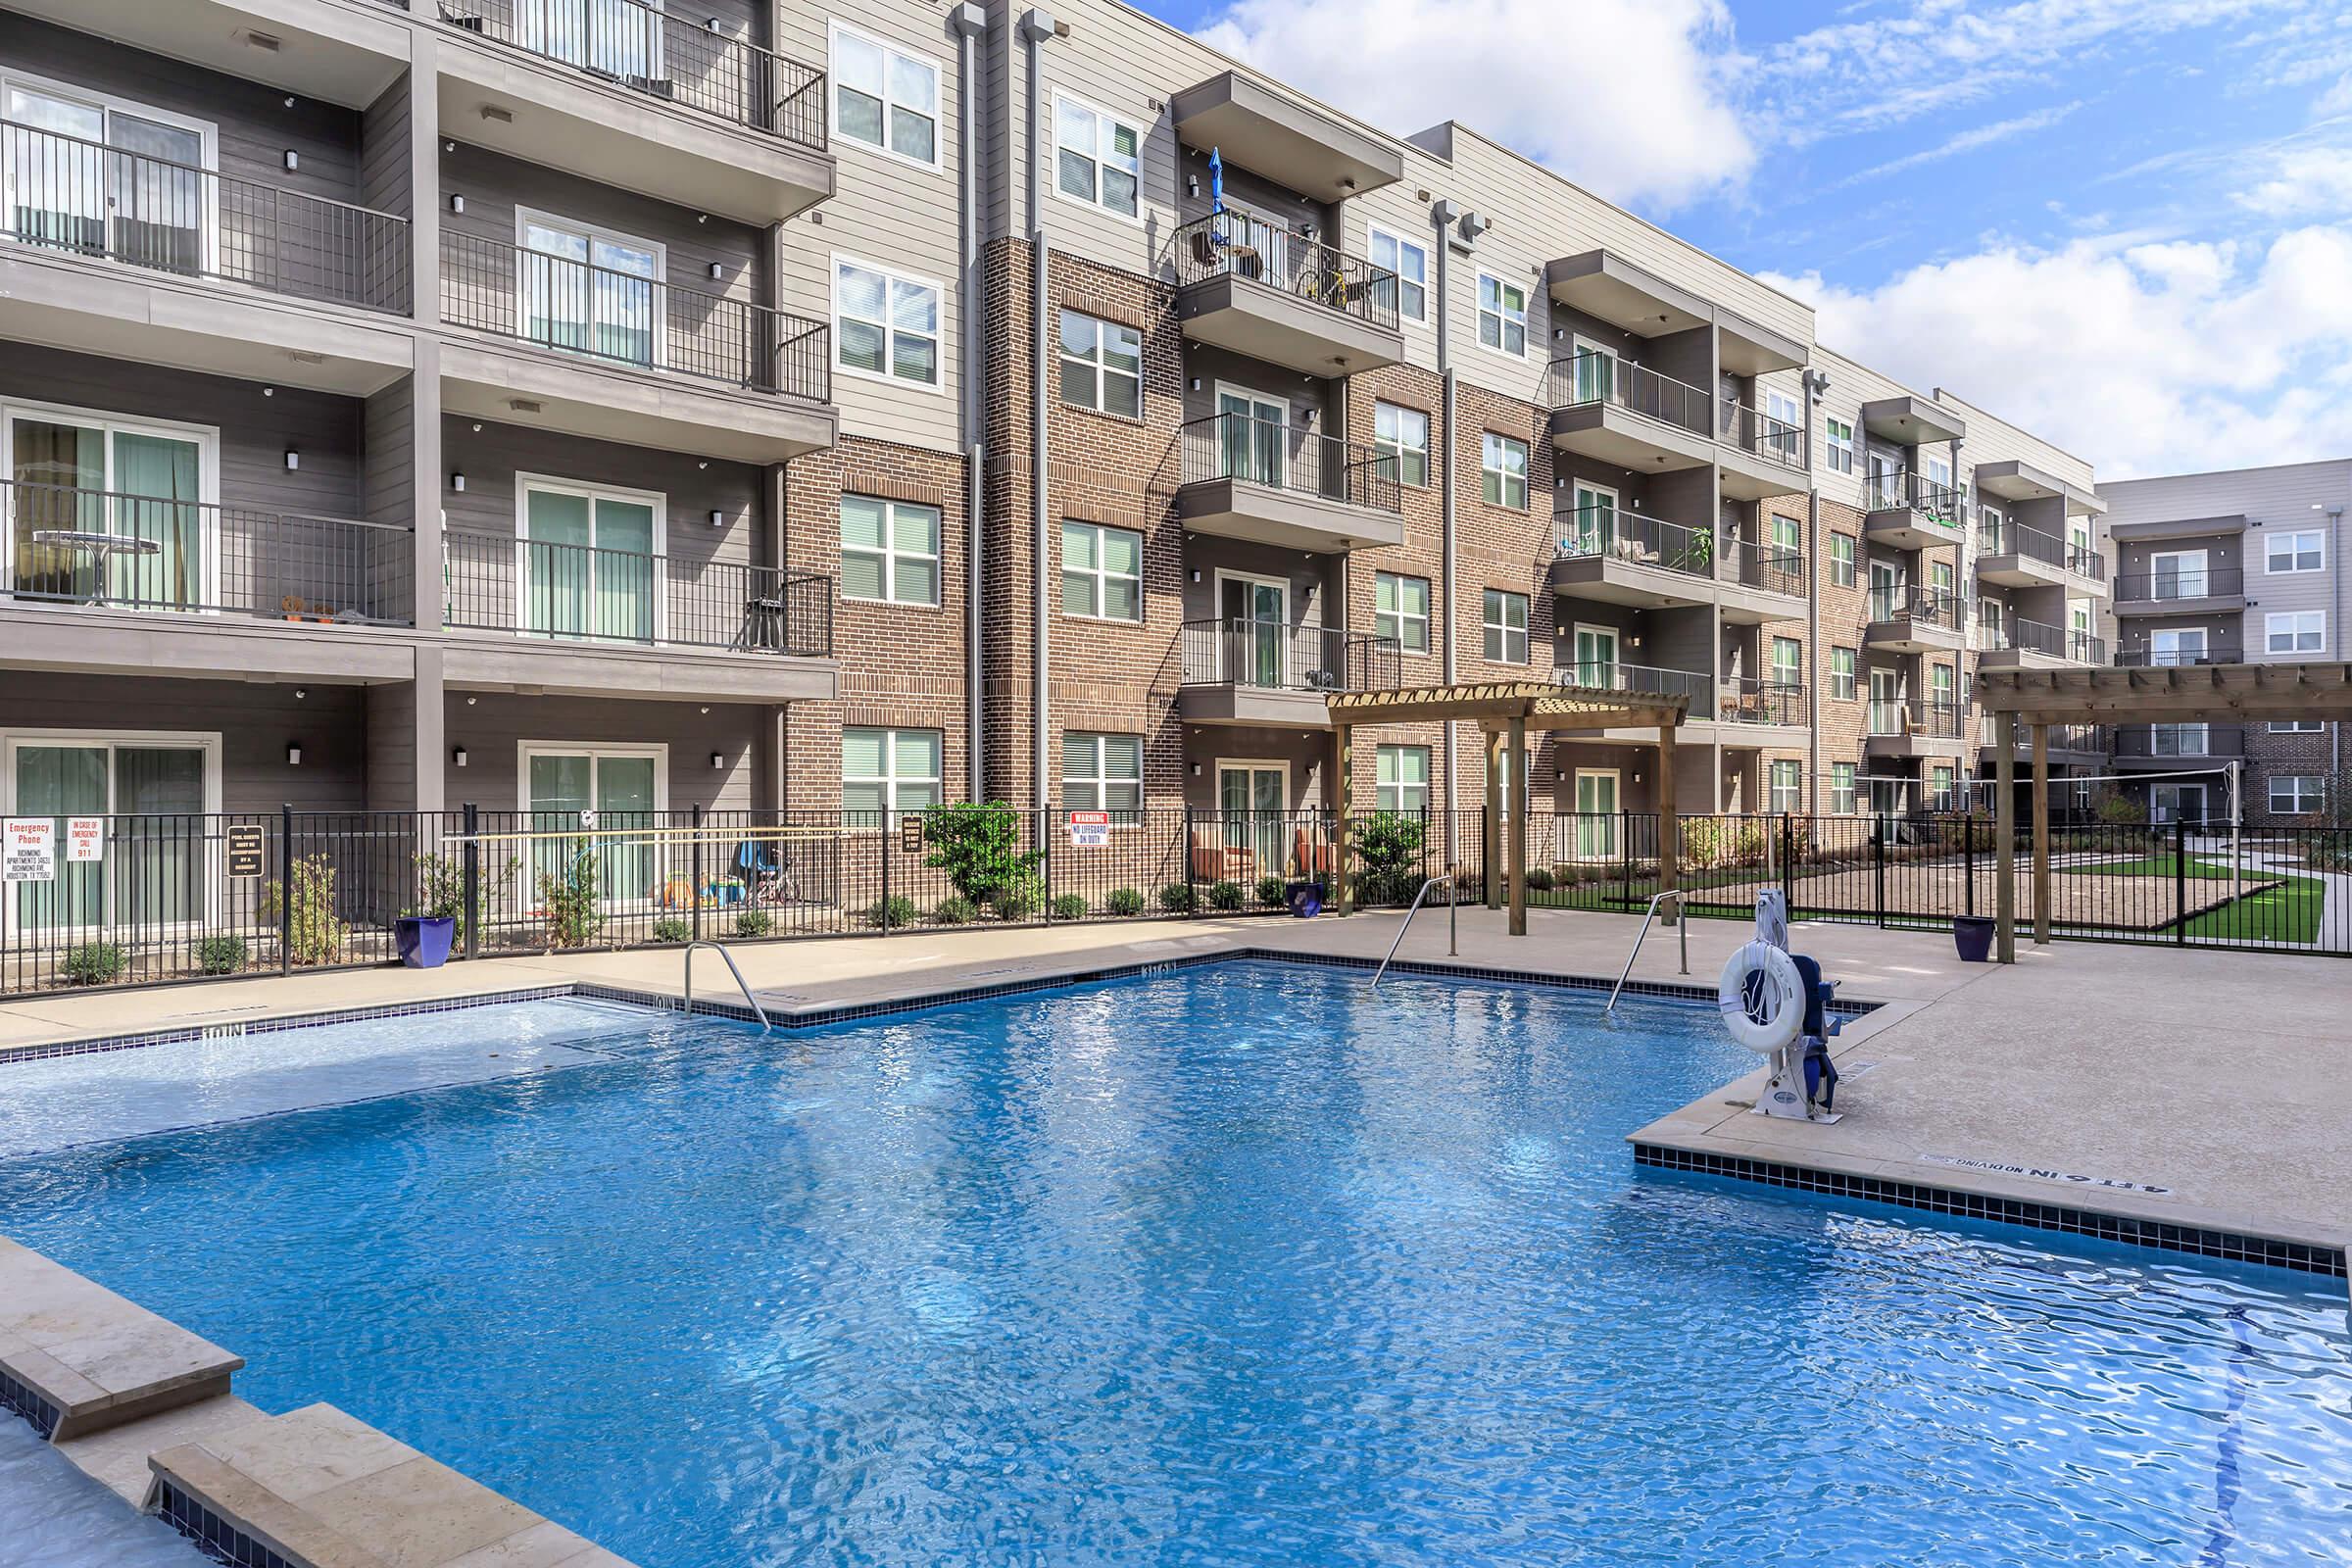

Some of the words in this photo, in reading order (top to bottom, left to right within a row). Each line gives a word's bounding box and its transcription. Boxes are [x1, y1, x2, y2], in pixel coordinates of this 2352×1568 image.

[1075, 813, 1104, 823] WARNING
[10, 823, 49, 834] Emergency
[1073, 825, 1080, 834] NO
[1081, 825, 1106, 834] LIFEGUARD
[19, 834, 41, 844] Phone
[1079, 835, 1087, 844] ON
[1088, 835, 1100, 844] DUTY
[1956, 1158, 2003, 1170] DIVING
[2005, 1164, 2024, 1173] NO
[2030, 1169, 2059, 1179] IN
[2098, 1179, 2133, 1189] FT
